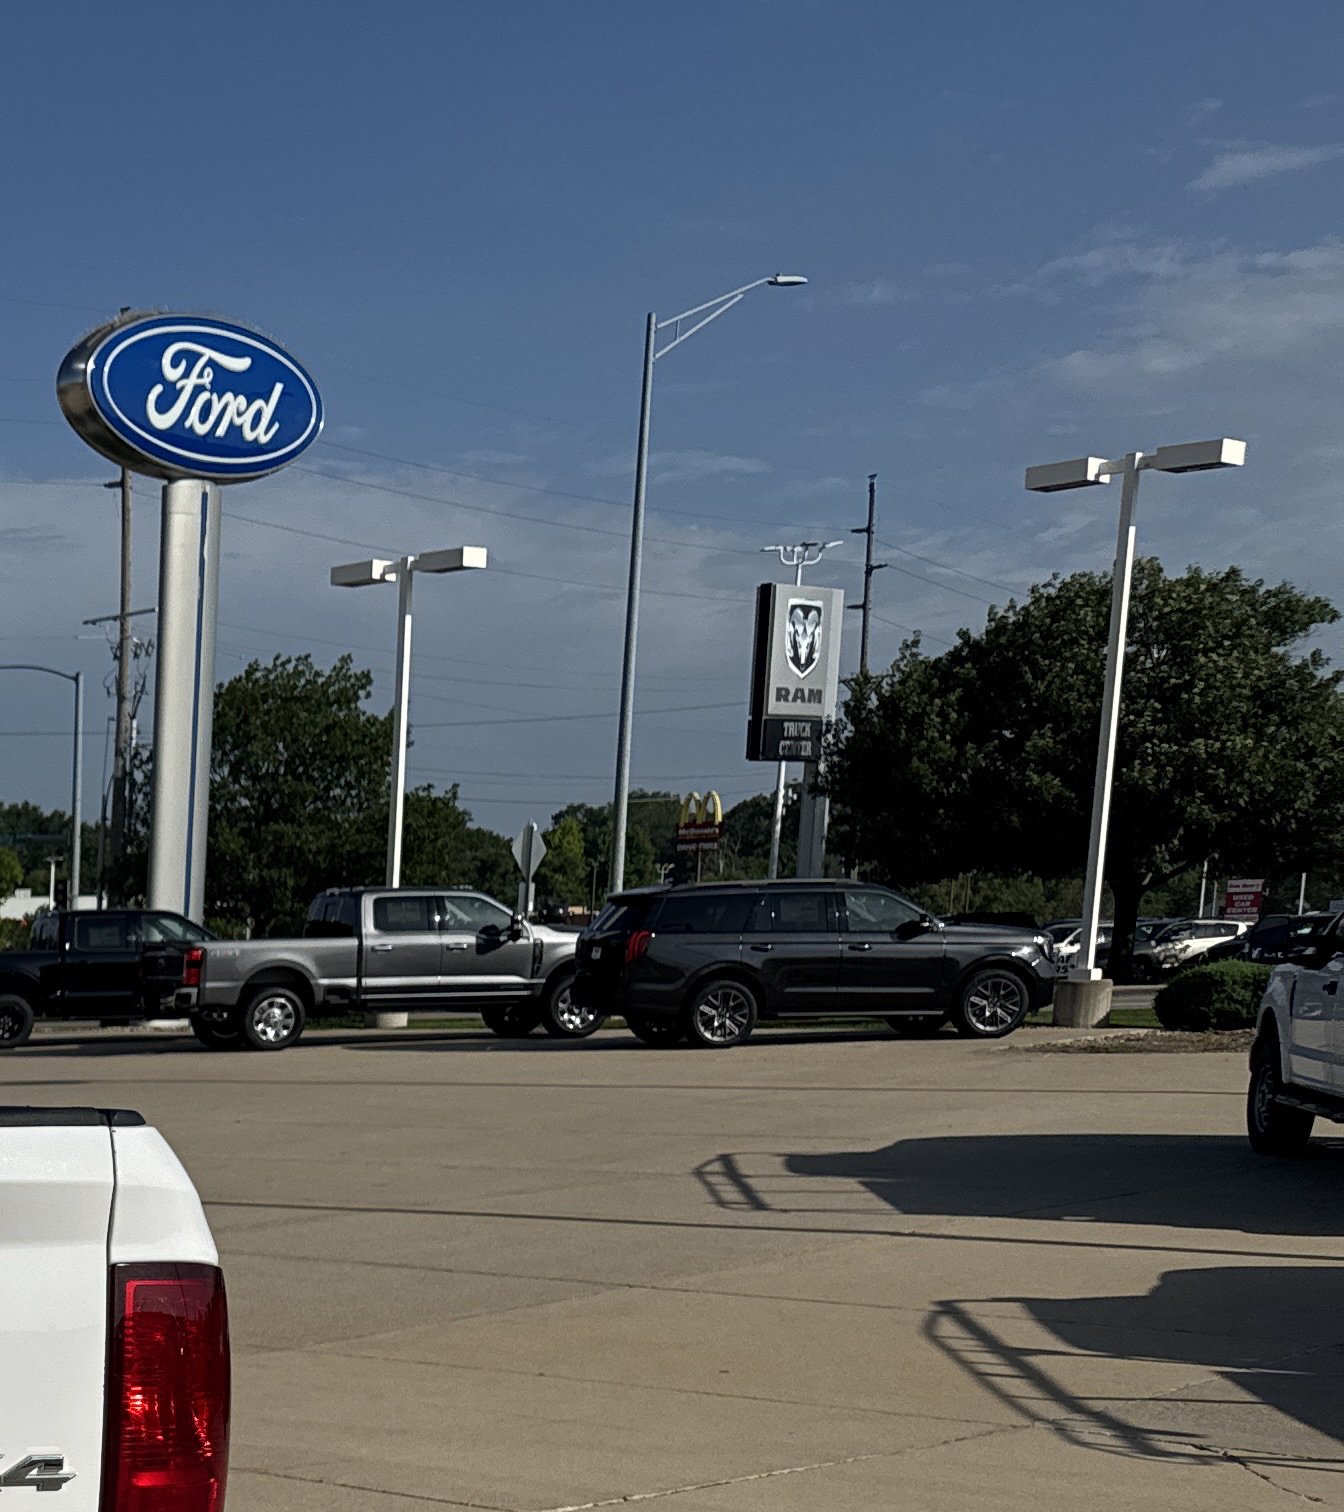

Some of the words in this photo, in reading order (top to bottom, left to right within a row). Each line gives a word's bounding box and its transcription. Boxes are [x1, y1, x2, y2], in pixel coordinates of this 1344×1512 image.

[146, 341, 285, 445] Ford
[775, 687, 823, 704] RAM
[783, 721, 812, 738] TRUCK
[778, 740, 812, 756] CENTER
